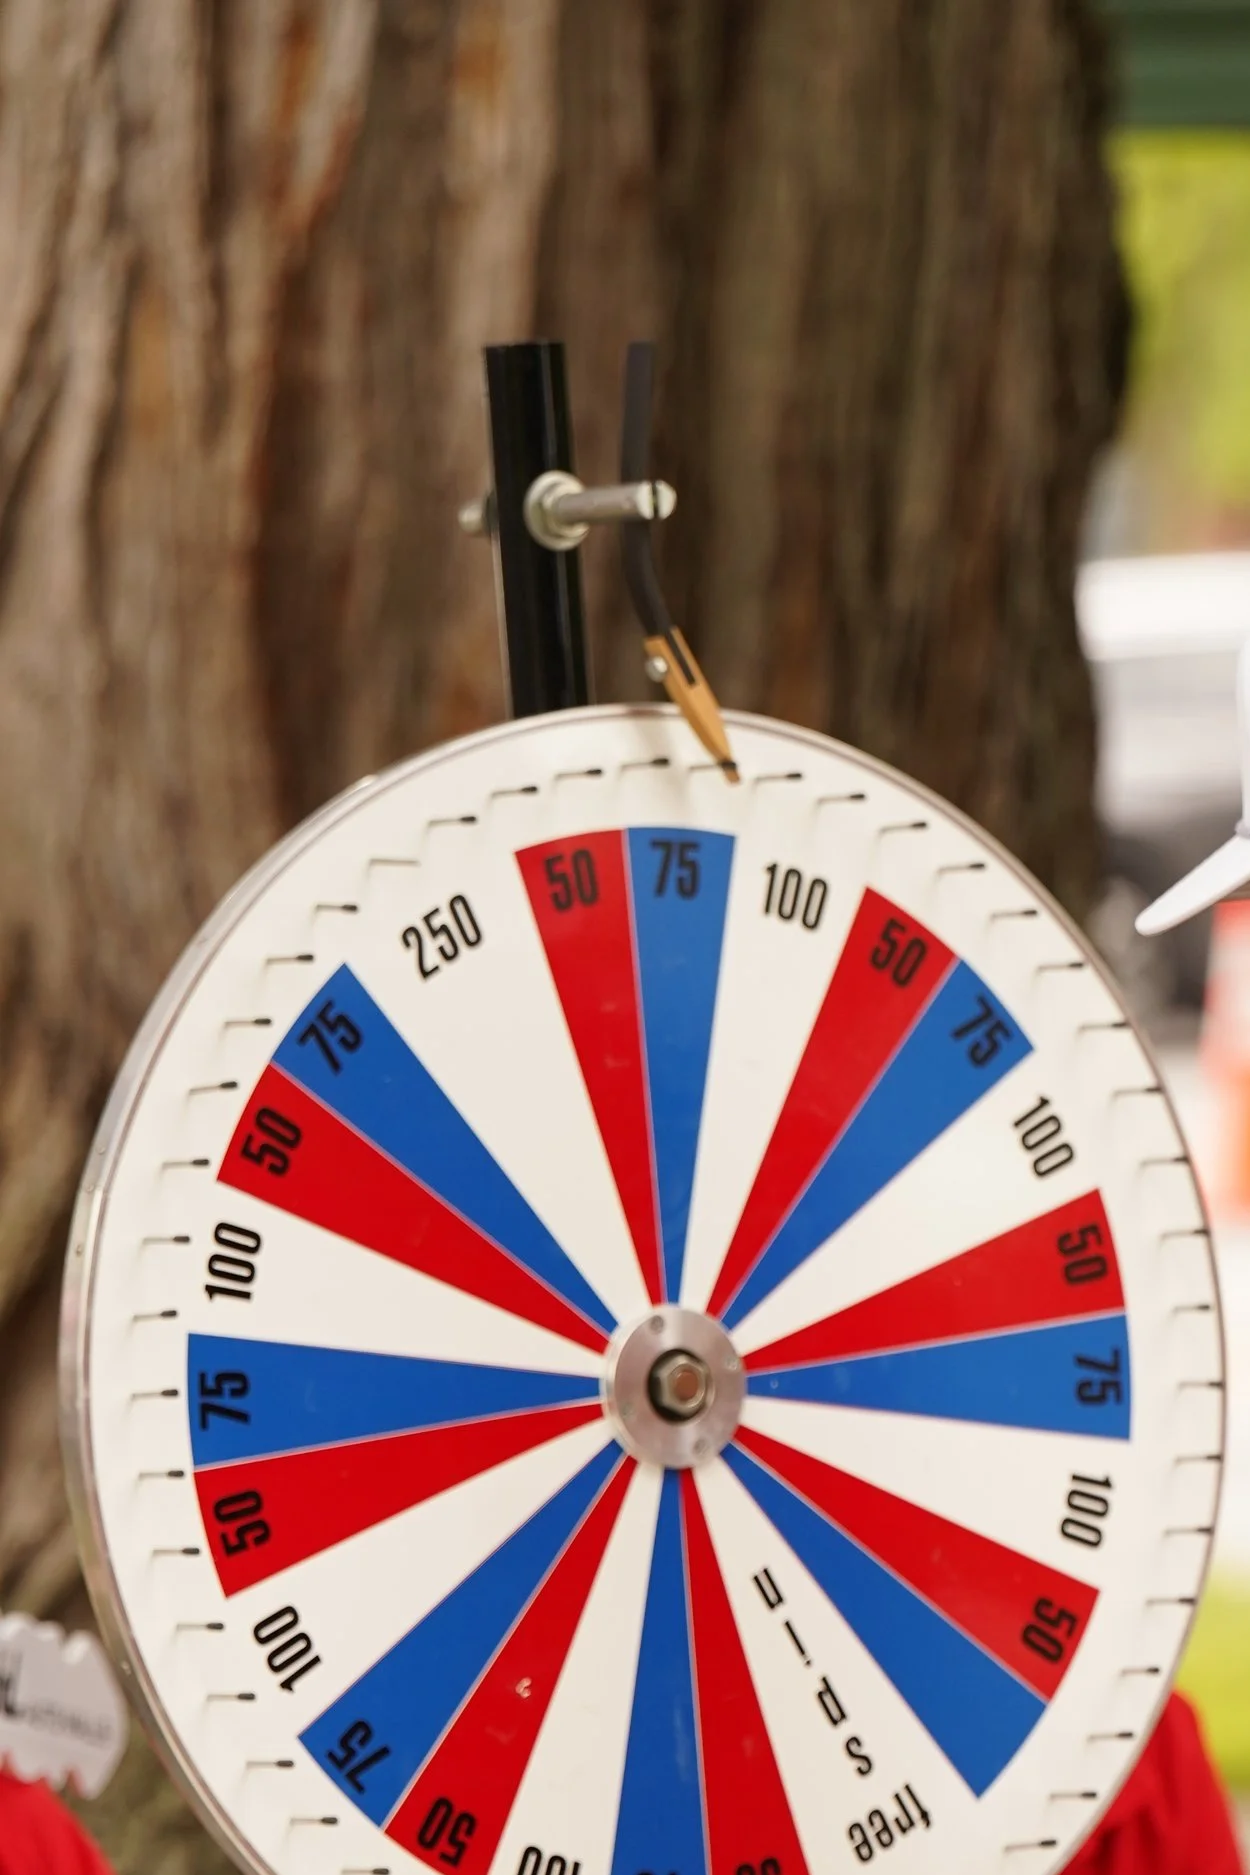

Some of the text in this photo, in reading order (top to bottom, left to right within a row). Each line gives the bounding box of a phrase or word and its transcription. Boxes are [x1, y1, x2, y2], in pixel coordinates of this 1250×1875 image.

[545, 850, 597, 910] 50
[651, 840, 699, 899] 75
[764, 863, 830, 931] 100
[401, 894, 482, 980] 250
[870, 919, 926, 986] 50
[297, 1000, 363, 1074] 75
[952, 996, 1013, 1067] 75
[241, 1107, 302, 1176] 50
[1013, 1096, 1074, 1178] 100
[204, 1222, 262, 1301] 100
[1058, 1224, 1107, 1284] 50
[198, 1371, 250, 1431] 75
[1075, 1350, 1122, 1405] 75
[213, 1490, 271, 1556] 50
[1060, 1474, 1112, 1548] 100
[252, 1604, 322, 1693] 100
[1022, 1598, 1077, 1662] 50
[326, 1719, 391, 1794] 75
[417, 1797, 476, 1867] 50
[848, 1784, 931, 1863] free
